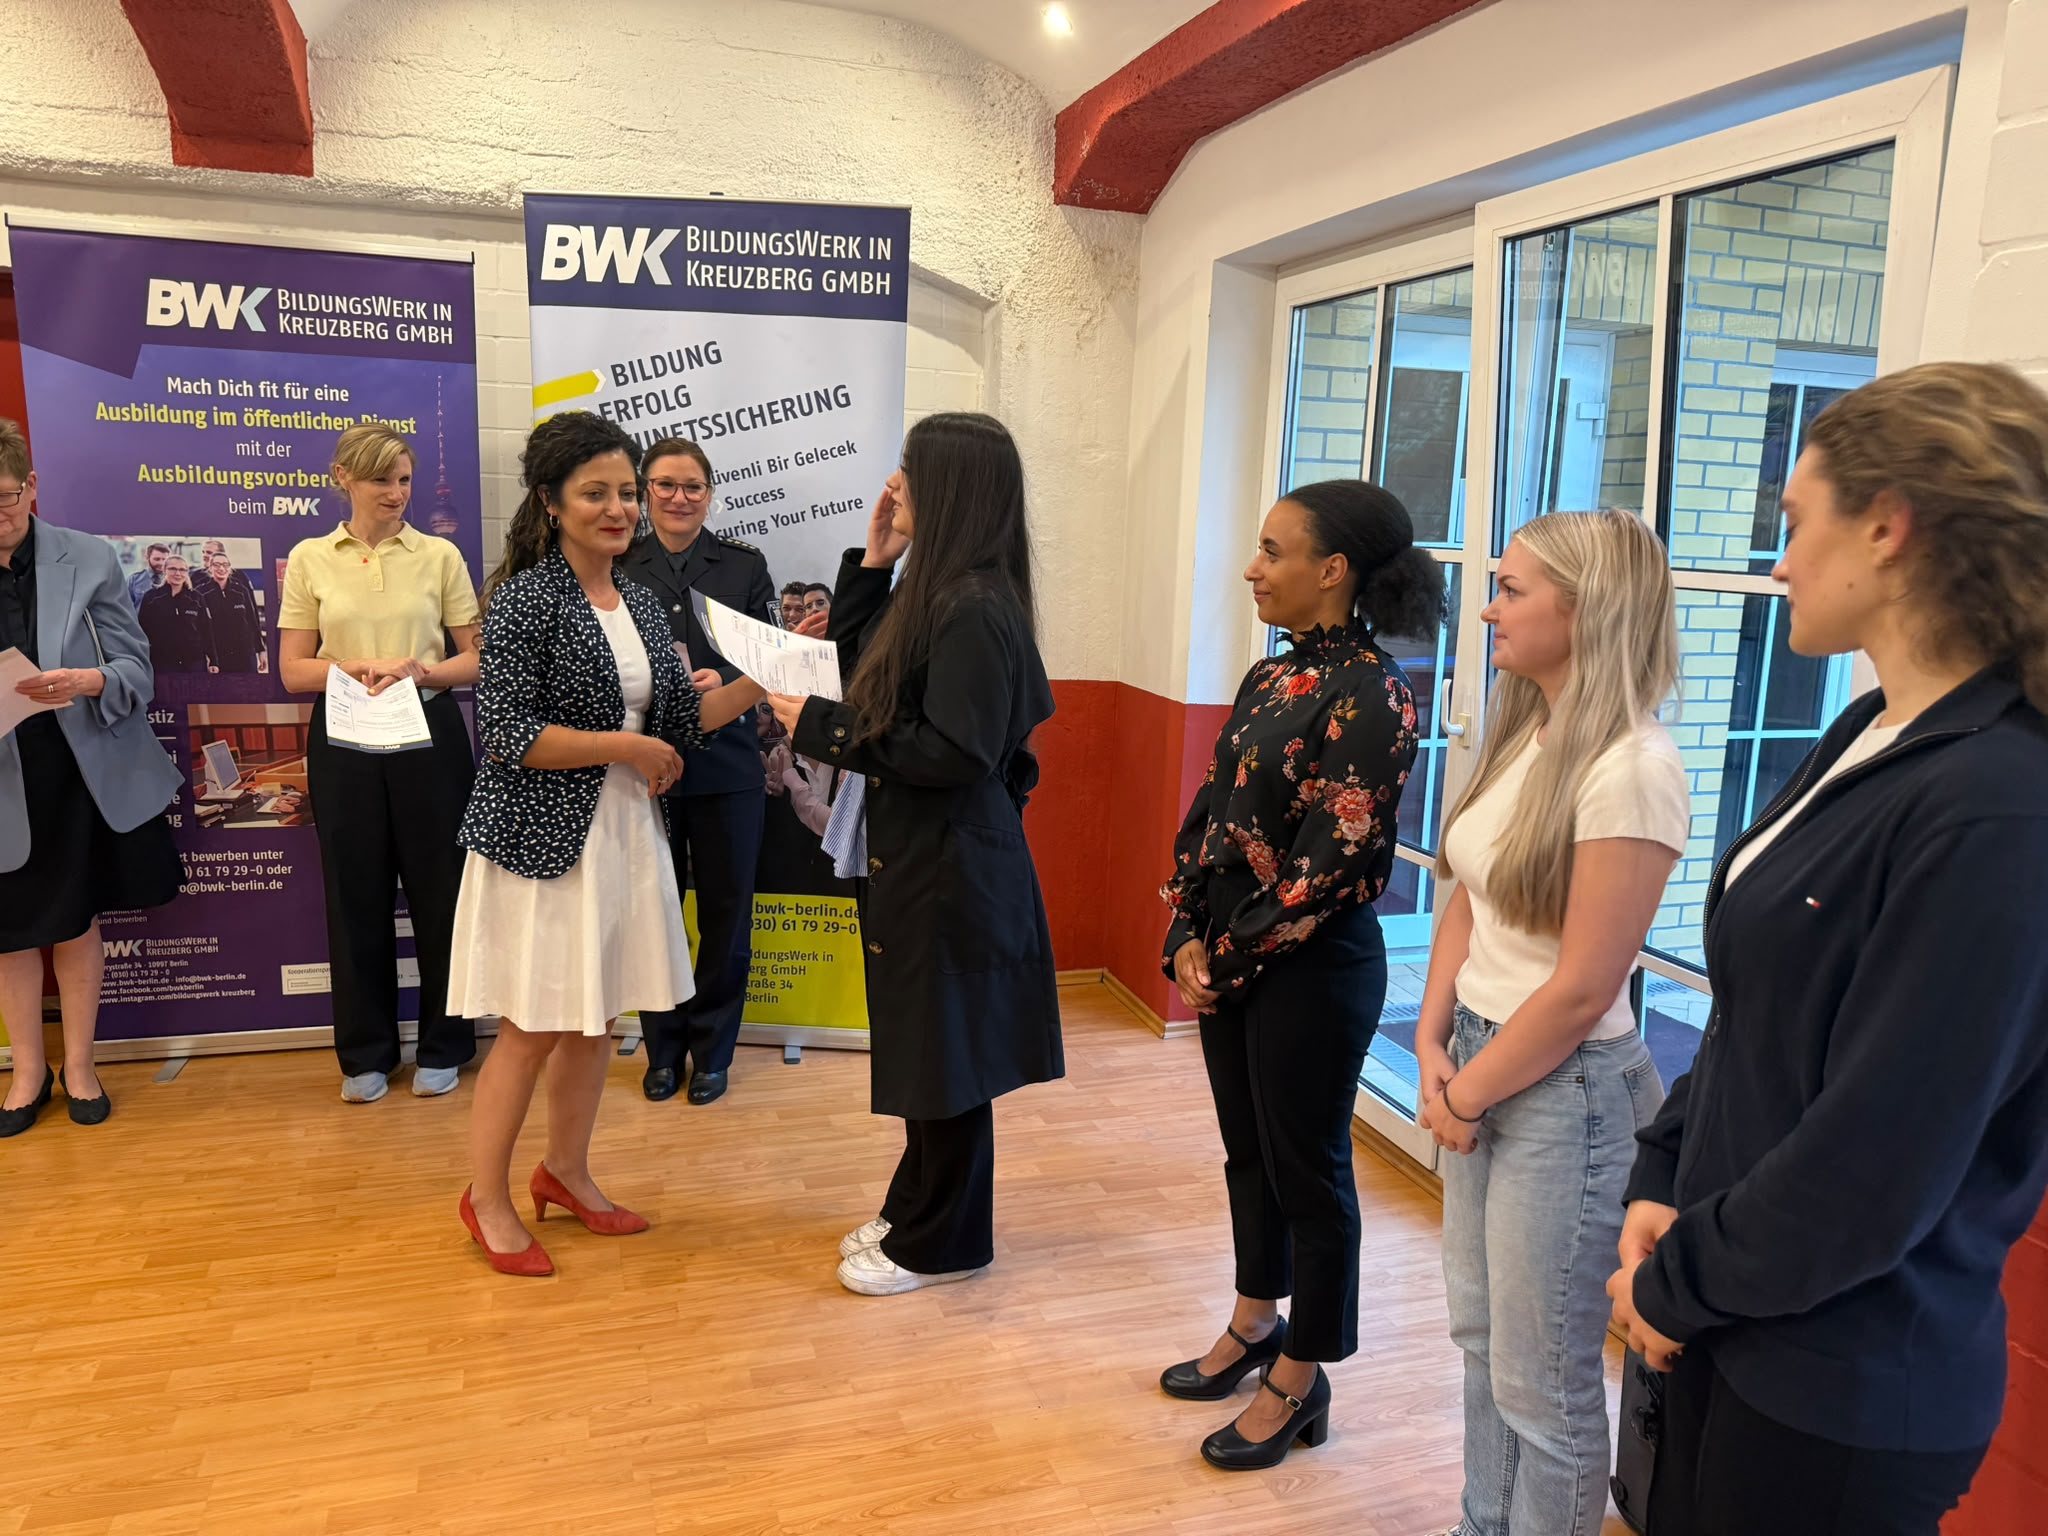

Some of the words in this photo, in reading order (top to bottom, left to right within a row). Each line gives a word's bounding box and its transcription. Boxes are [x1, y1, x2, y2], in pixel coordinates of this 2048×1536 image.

[540, 223, 682, 286] BWK
[868, 237, 892, 261] IN
[146, 278, 273, 332] BWK
[433, 303, 453, 322] IN
[610, 340, 723, 388] BILDUNG
[167, 376, 212, 395] Mach
[218, 379, 254, 398] Dich
[259, 381, 279, 399] fit
[283, 382, 309, 401] für
[314, 384, 349, 402] eine
[598, 384, 692, 422] ERFOLG
[96, 402, 207, 429] Ausbildung
[213, 406, 237, 427] im
[243, 408, 354, 431] öffentlichen
[634, 384, 852, 451] UNFTSSICHERUNG
[236, 440, 262, 457] mit
[266, 441, 292, 458] der
[711, 460, 762, 485] üvenli
[767, 455, 790, 474] Bir
[794, 440, 858, 467] Gelecek
[228, 498, 266, 515] beim
[272, 496, 320, 516] BWK
[724, 487, 786, 511] Success
[771, 510, 806, 529] Your
[810, 497, 864, 520] Future
[144, 709, 175, 724] stiz
[191, 850, 249, 862] bewerben
[253, 850, 284, 860] unter
[196, 867, 211, 877] 61
[215, 866, 230, 876] 79
[267, 864, 293, 875] oder
[178, 879, 283, 895] o@bwk-berlin.de
[782, 919, 797, 931] 61
[802, 920, 818, 932] 79
[750, 949, 819, 962] ldungsWerk
[822, 952, 834, 962] in
[771, 964, 807, 975] GmbH
[780, 980, 794, 990] 34
[745, 992, 779, 1004] Berlin
